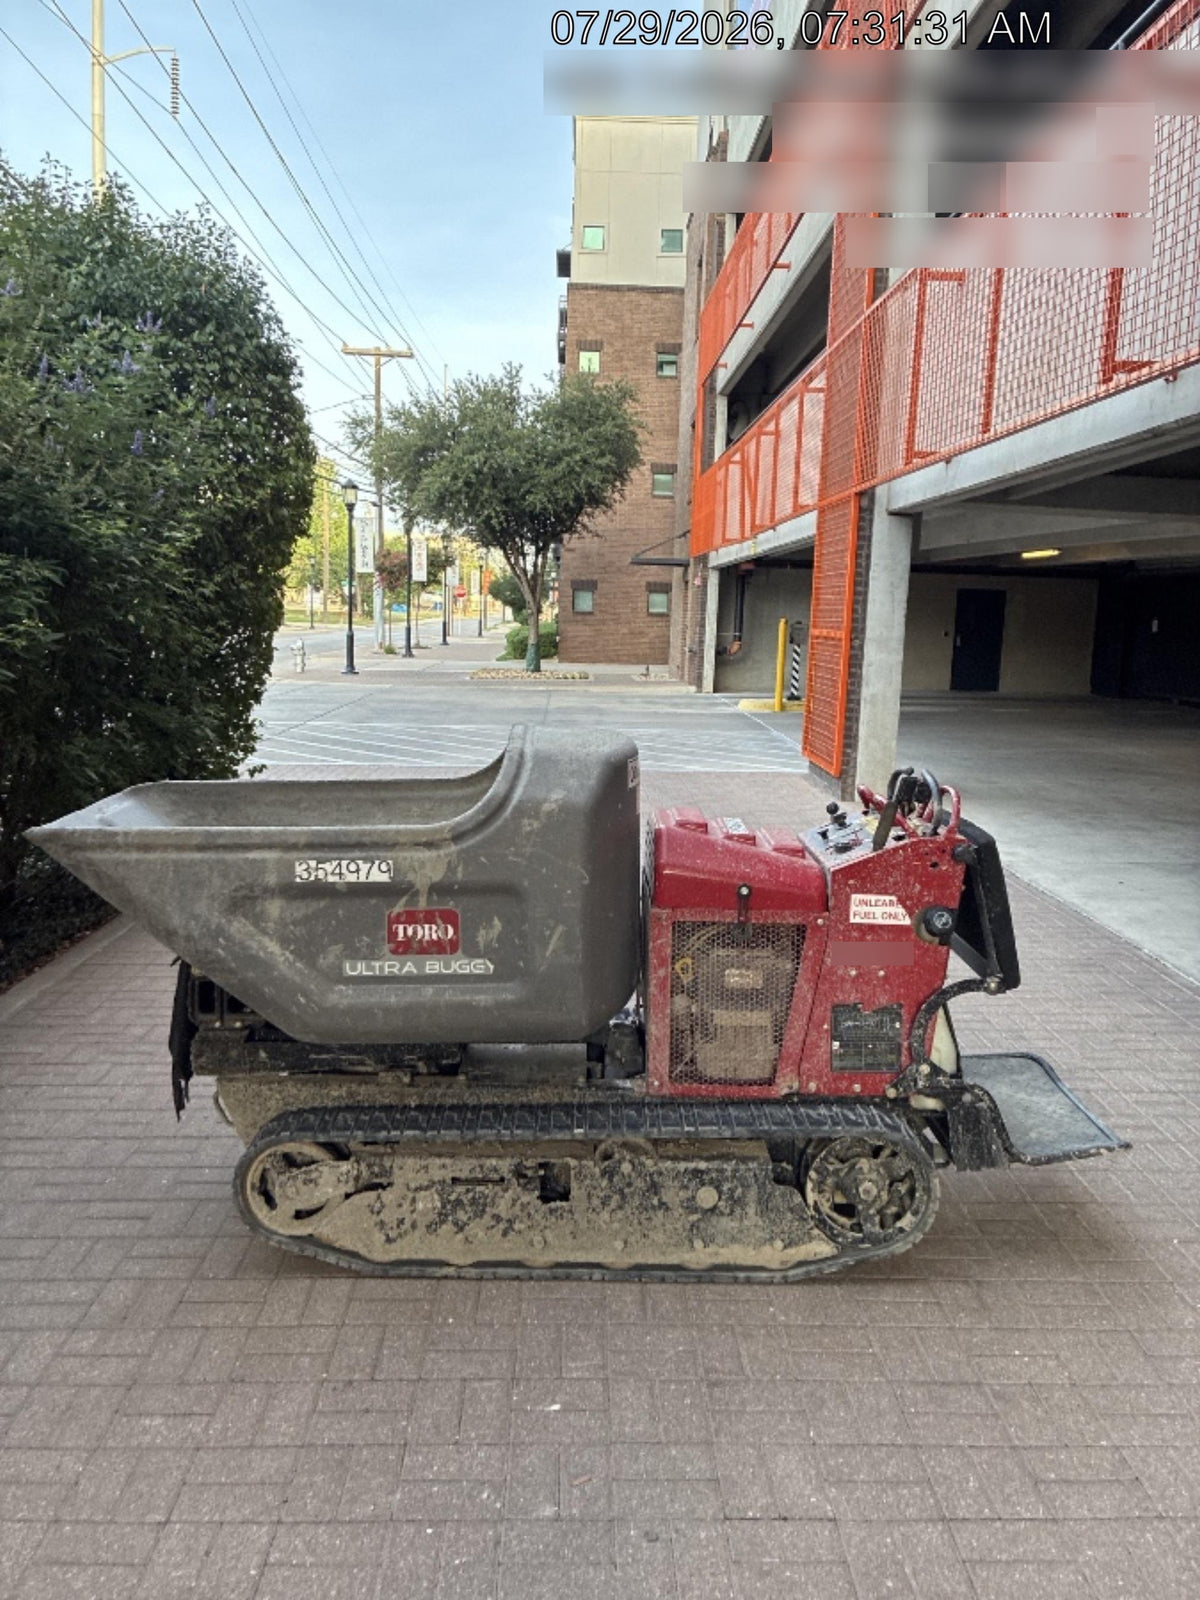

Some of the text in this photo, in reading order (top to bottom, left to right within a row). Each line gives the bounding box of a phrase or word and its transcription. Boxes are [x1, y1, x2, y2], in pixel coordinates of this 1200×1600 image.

[295, 860, 393, 881] 354979
[853, 911, 908, 921] FUEL ONLY
[393, 923, 455, 941] TORO
[345, 959, 495, 975] ULTRA BUGGY
